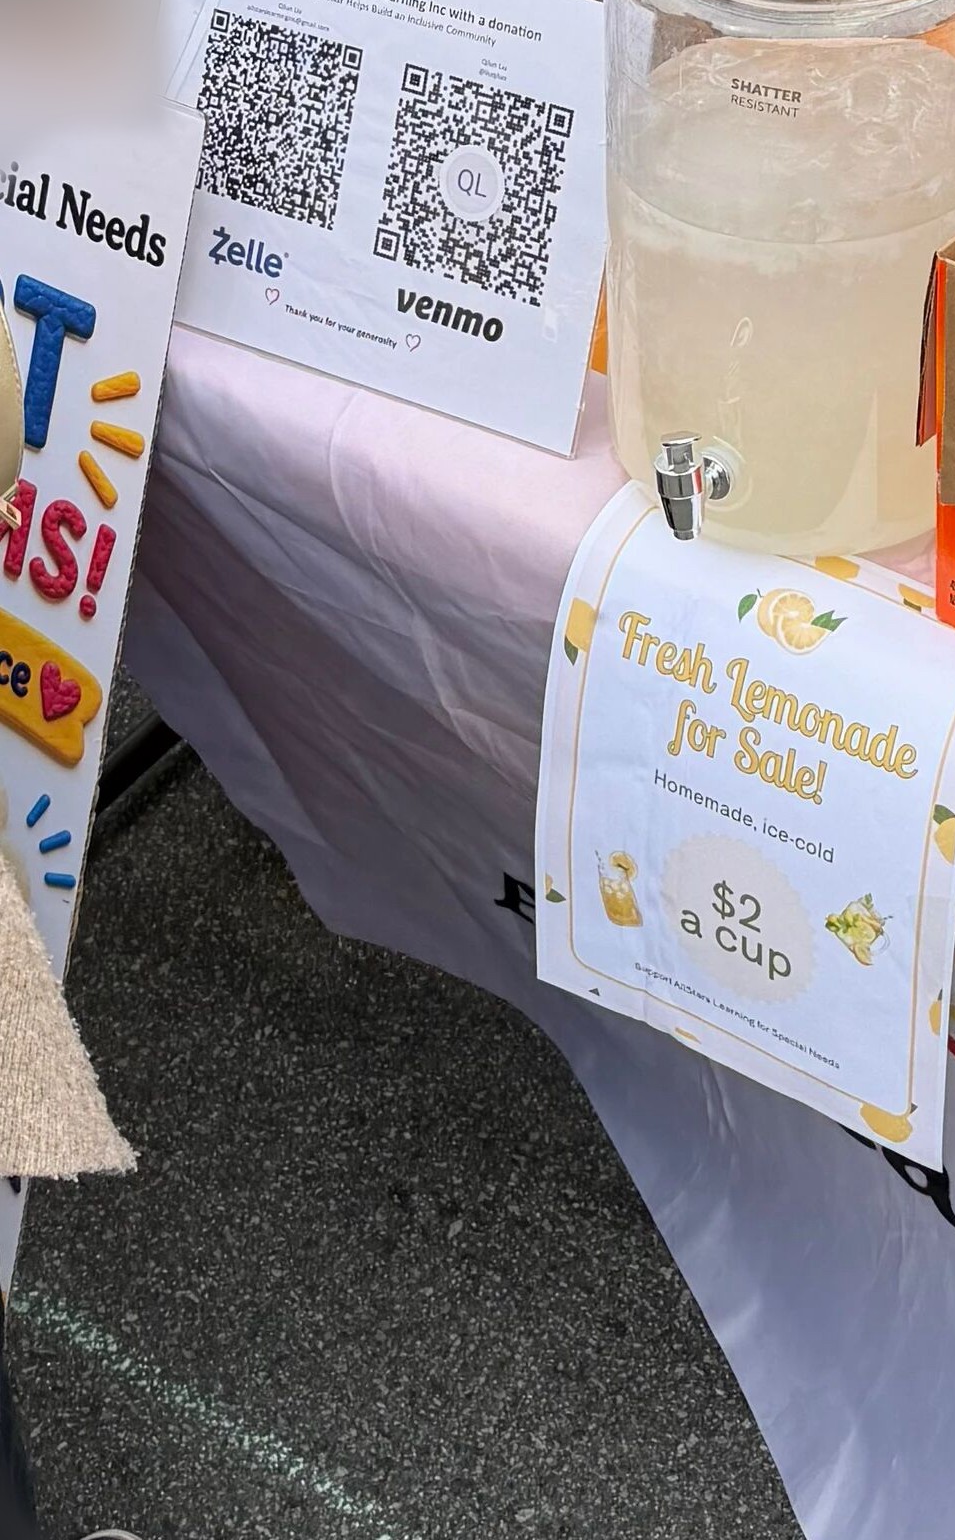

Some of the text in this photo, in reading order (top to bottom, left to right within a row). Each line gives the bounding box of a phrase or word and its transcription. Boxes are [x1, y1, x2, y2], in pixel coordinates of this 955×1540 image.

[371, 3, 393, 19] Build
[394, 11, 406, 22] an
[407, 13, 444, 32] Inclusive
[445, 23, 498, 48] Community
[428, 1, 447, 17] Inc
[449, 7, 475, 25] with
[478, 14, 486, 27] a
[488, 17, 543, 43] donation
[730, 94, 801, 118] RESISTANT
[731, 78, 802, 103] SHATTER
[458, 168, 487, 198] QL
[55, 182, 167, 267] Needs
[285, 304, 399, 350] Thank you for your generosity
[396, 287, 505, 344] venmo
[617, 610, 919, 780] Fresh Lemonade
[666, 698, 829, 806] for Sale!
[653, 768, 835, 865] Homemade, ice-cold
[712, 879, 762, 934] $2
[680, 909, 792, 981] a cup
[633, 961, 840, 1070] Support AllStars Learning for Special Needs
